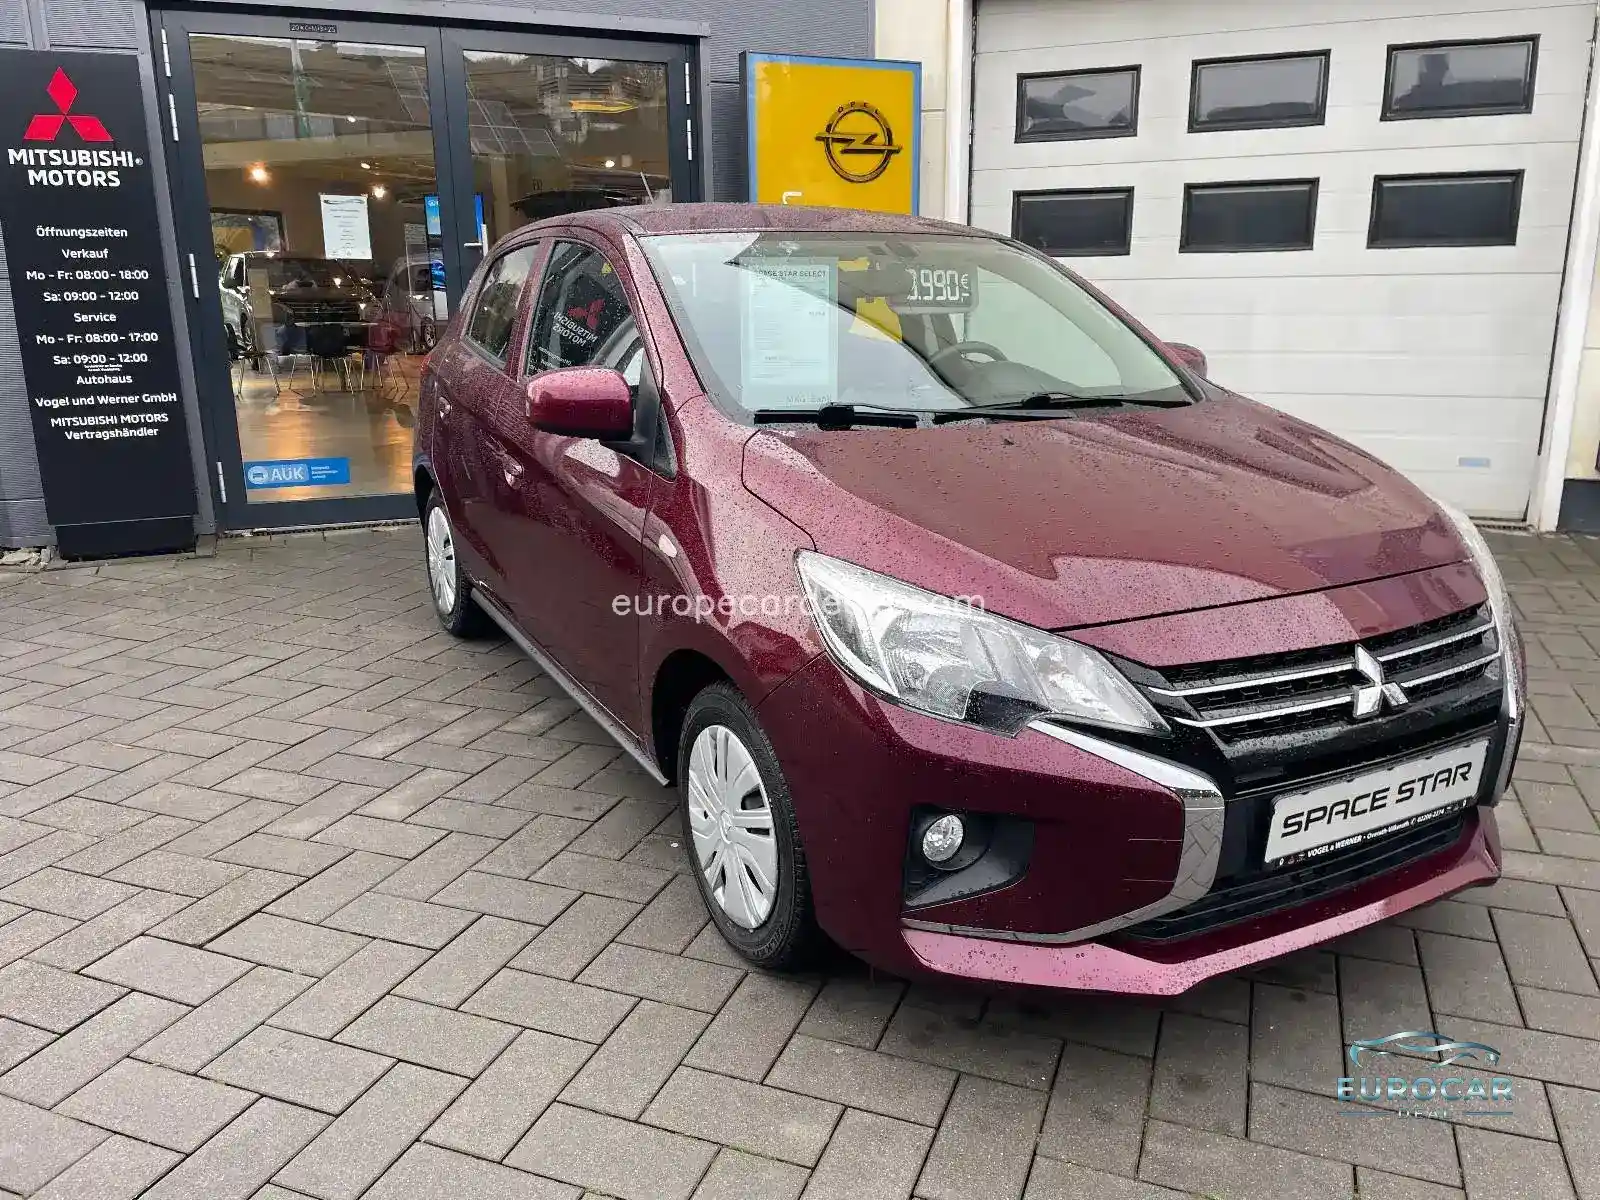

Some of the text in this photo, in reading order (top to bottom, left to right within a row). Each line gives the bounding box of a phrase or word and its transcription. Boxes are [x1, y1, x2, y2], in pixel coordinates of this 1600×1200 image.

[837, 100, 880, 114] OPEL
[8, 148, 134, 168] MITSUBISHI
[28, 169, 121, 187] MOTORS
[36, 225, 129, 239] Öffnungszeiten
[61, 248, 109, 259] Verkauf
[26, 270, 46, 280] Mo
[57, 270, 73, 280] Fr:
[75, 270, 110, 280] 08:00
[118, 269, 149, 280] 18:00
[779, 270, 798, 278] STAR
[799, 270, 827, 278] SELECT
[43, 291, 62, 302] Sa:
[63, 291, 97, 301] 09:00
[108, 290, 139, 301] 12:00
[73, 312, 117, 323] Service
[35, 334, 55, 345] Mo
[85, 333, 119, 344] 08:00
[128, 332, 159, 343] 17:00
[53, 355, 71, 366] Sa:
[73, 354, 107, 365] 09:00
[117, 353, 148, 364] 12:00
[76, 374, 133, 385] Autohaus
[35, 392, 177, 409] Vogel und Werner GmbH
[50, 413, 169, 427] MITSUBISHI MOTORS
[64, 426, 159, 440] Vertragshändler
[1280, 761, 1473, 839] SPACE STAR
[1308, 845, 1330, 858] VOGEL
[1335, 834, 1363, 850] WERNER
